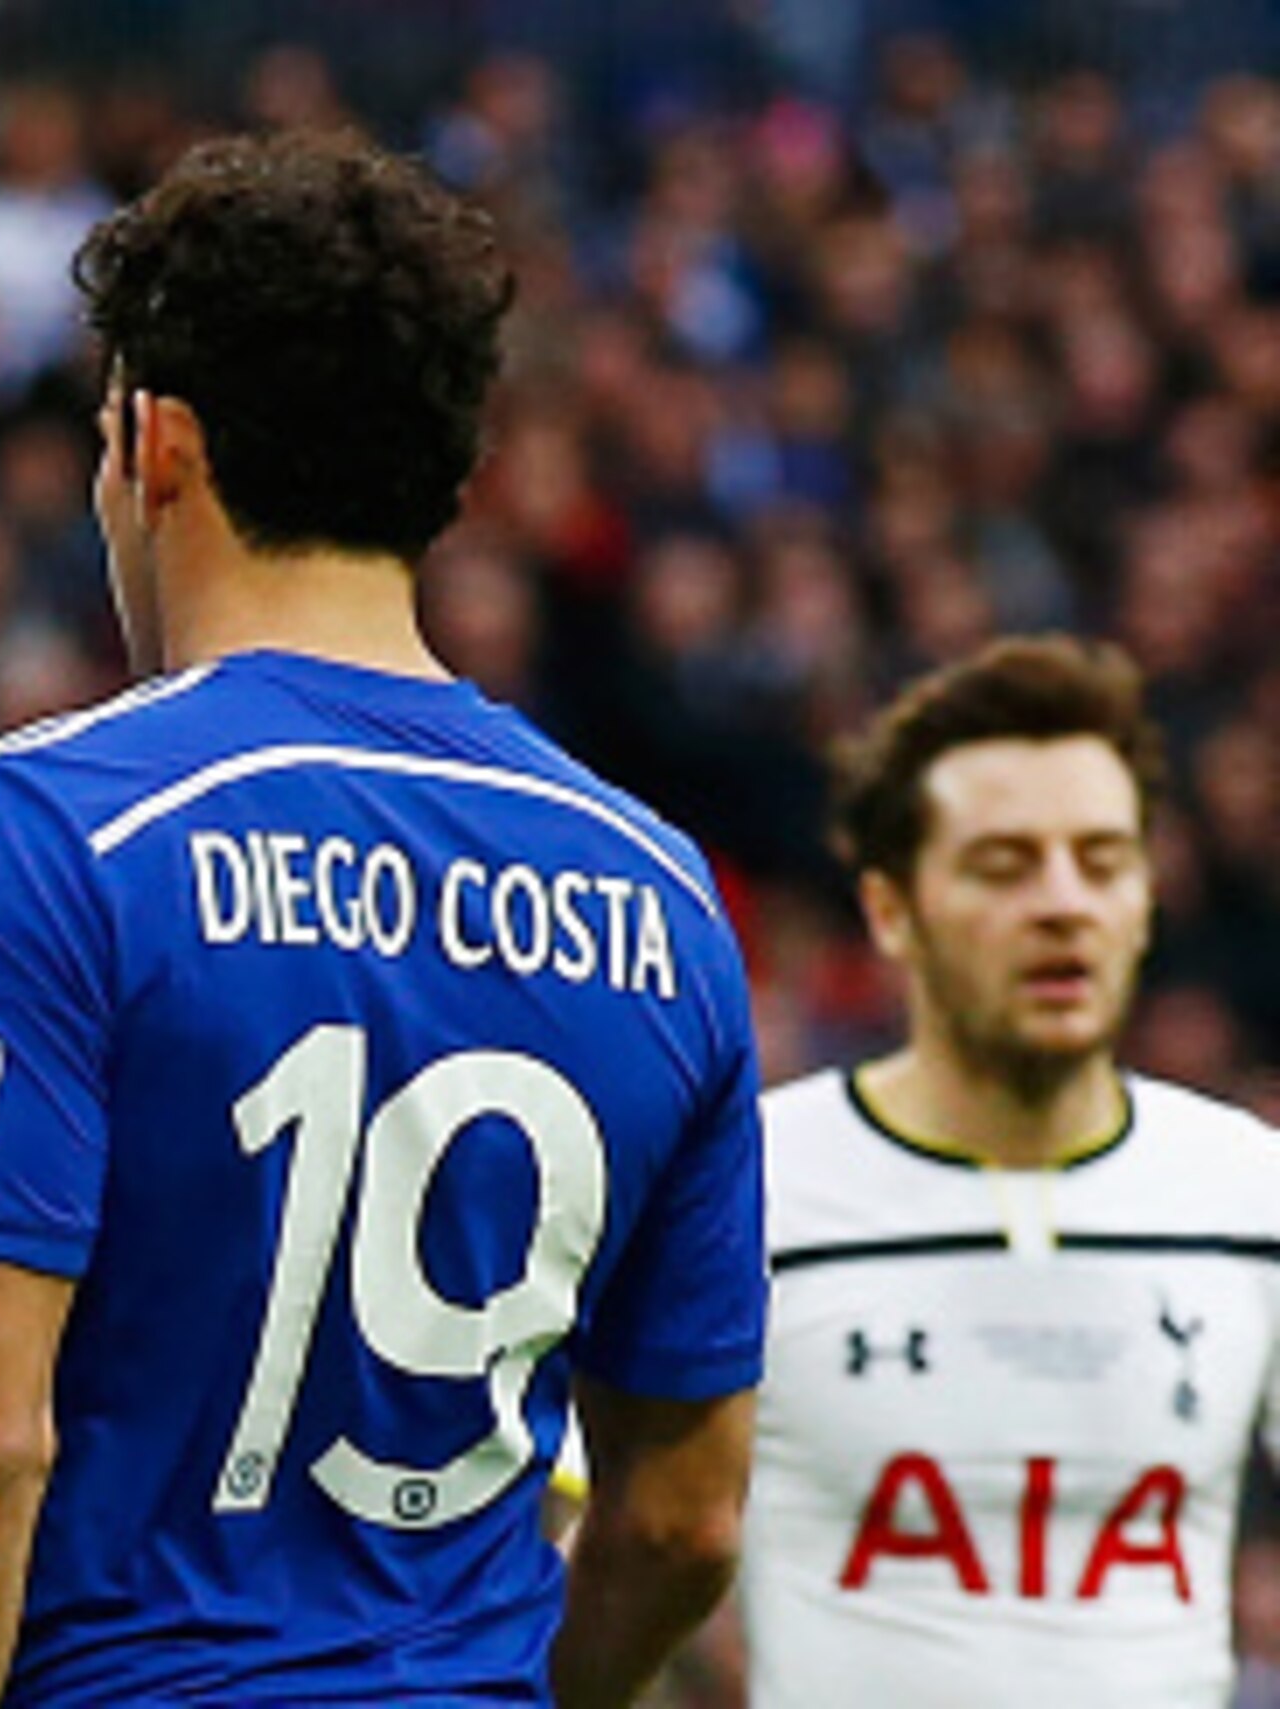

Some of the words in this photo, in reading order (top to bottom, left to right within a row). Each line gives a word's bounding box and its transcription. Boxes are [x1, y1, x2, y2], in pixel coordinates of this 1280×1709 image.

[189, 830, 416, 957] DIEGO
[440, 857, 676, 1000] COSTA
[212, 1024, 607, 1530] 19
[838, 1450, 1192, 1605] AIA
